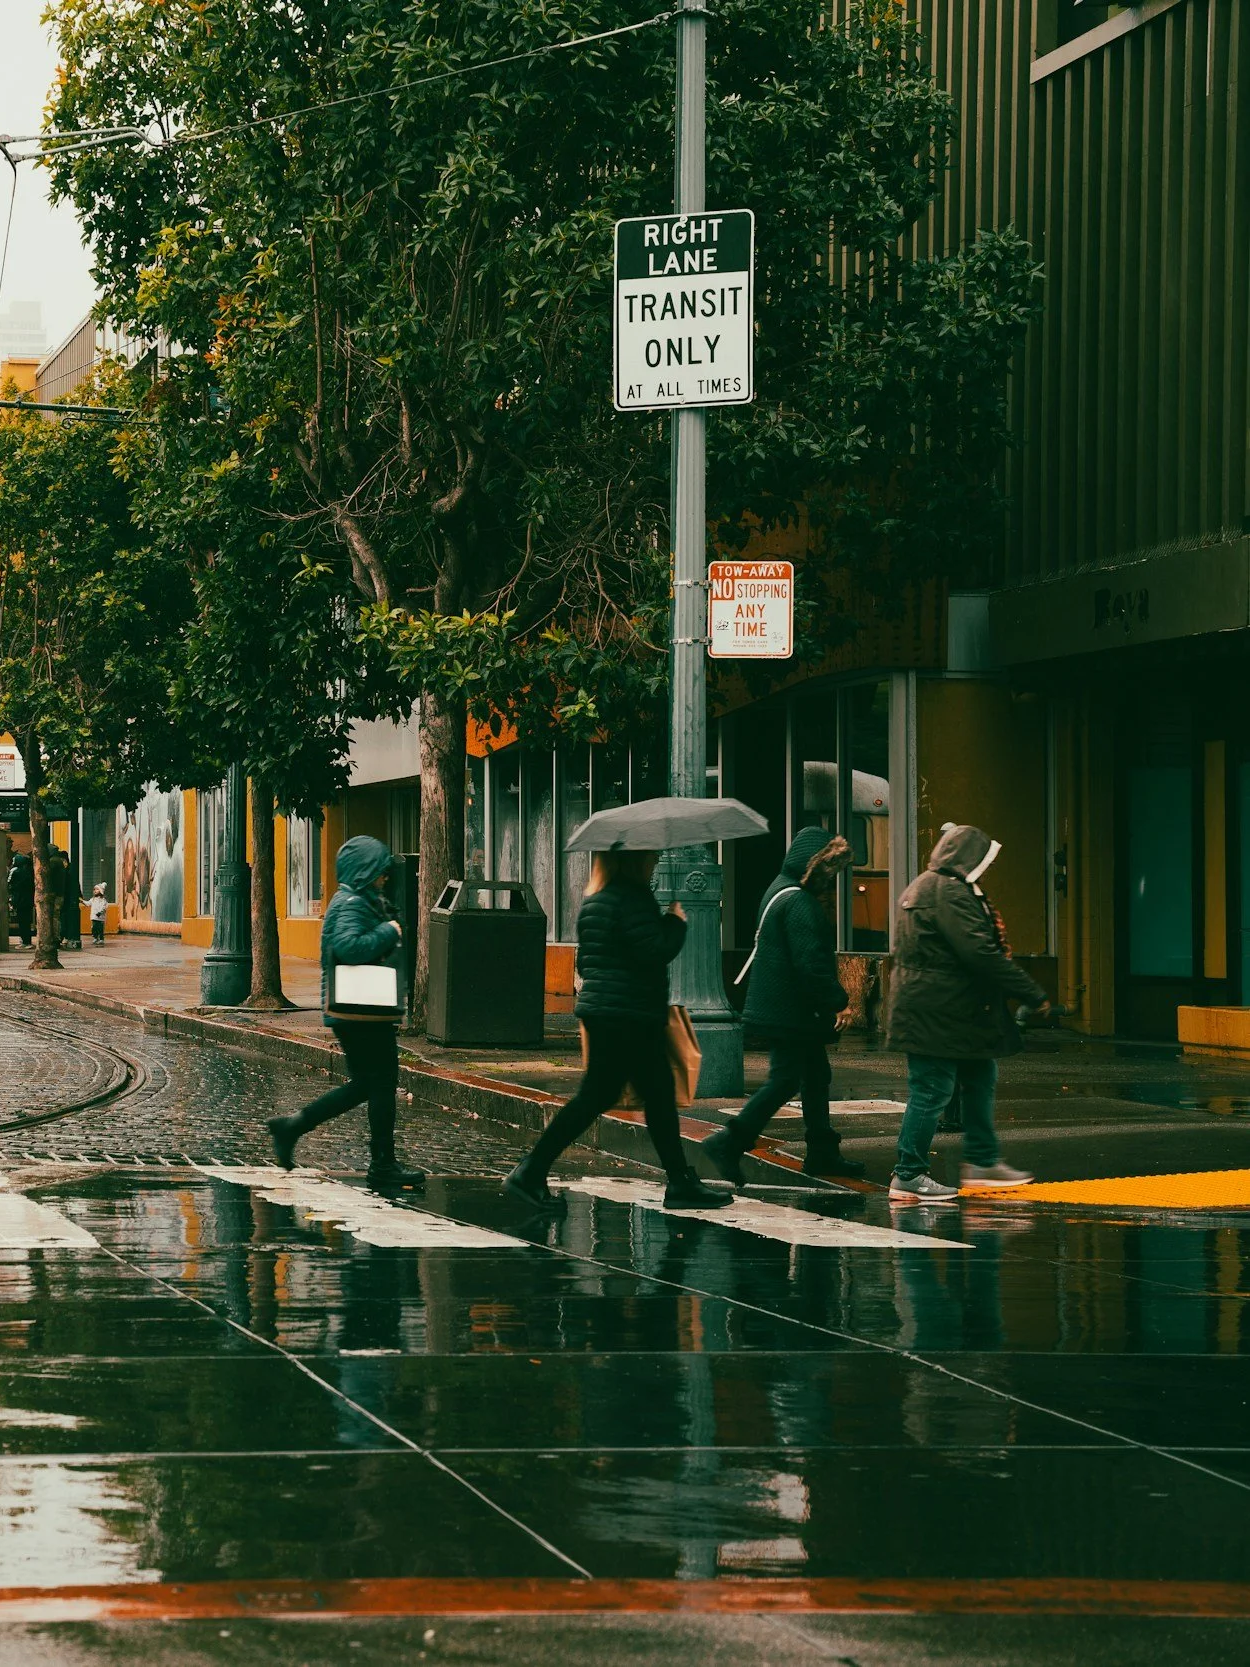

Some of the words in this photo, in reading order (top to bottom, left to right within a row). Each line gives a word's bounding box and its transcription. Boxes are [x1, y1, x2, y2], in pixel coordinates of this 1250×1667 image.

[644, 219, 723, 247] RIGHT
[649, 249, 717, 276] LANE
[624, 287, 742, 323] TRANSIT
[645, 335, 721, 368] ONLY
[627, 384, 643, 399] AT
[657, 381, 684, 397] ALL
[697, 377, 742, 395] TIMES
[717, 565, 785, 577] TOW-AWAY
[712, 578, 733, 599] NO
[737, 583, 787, 599] STOPPING
[735, 604, 766, 618] ANY
[734, 622, 767, 637] TIME
